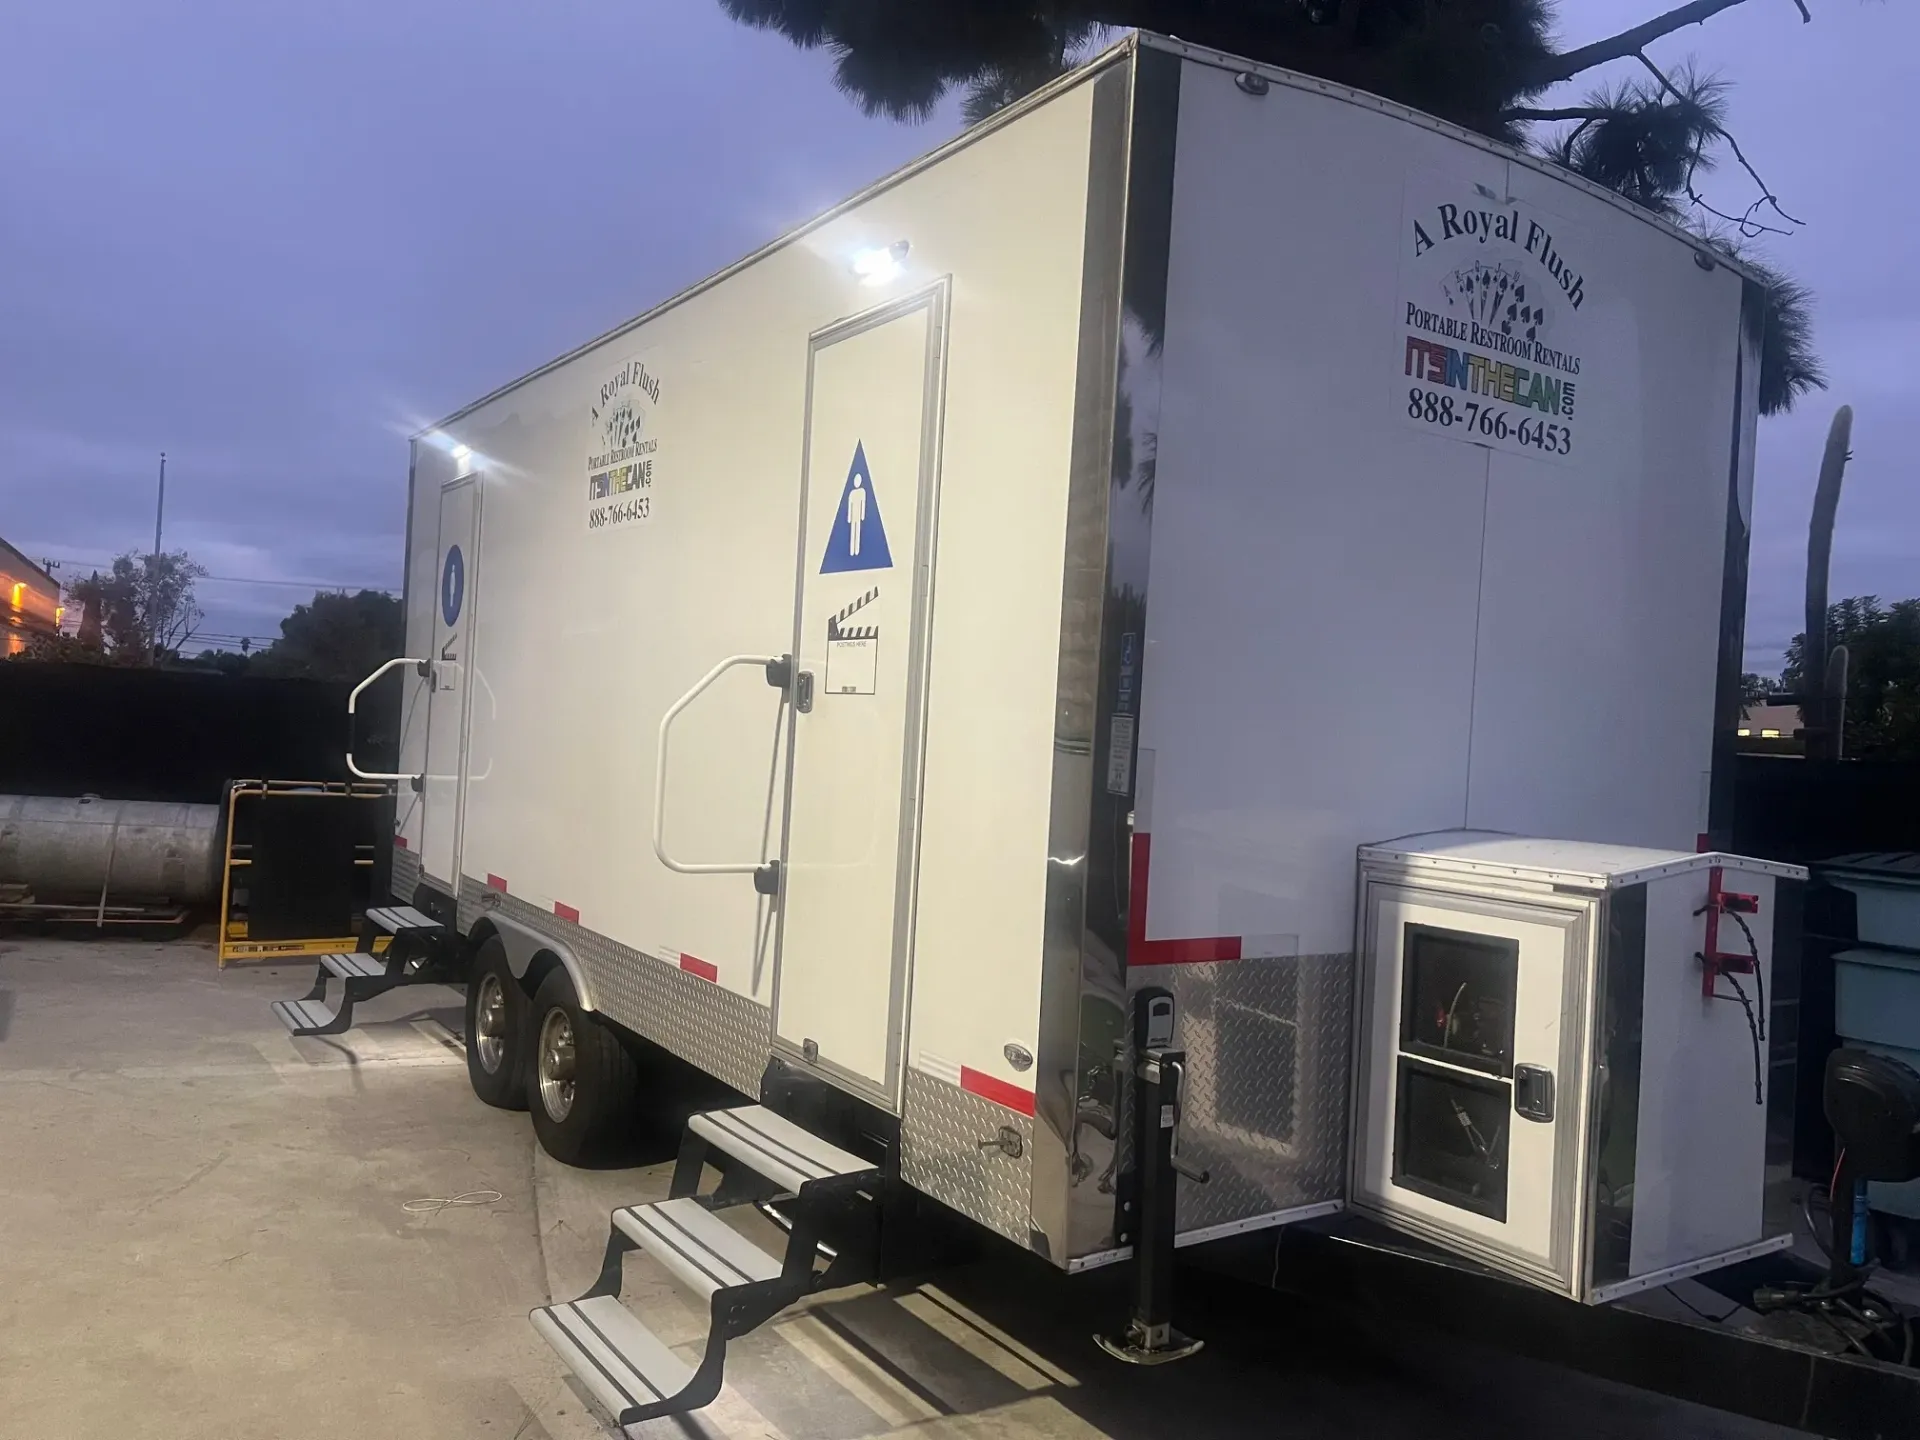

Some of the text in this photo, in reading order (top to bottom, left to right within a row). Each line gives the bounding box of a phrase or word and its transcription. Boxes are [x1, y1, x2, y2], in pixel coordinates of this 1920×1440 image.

[1413, 203, 1584, 312] A Royal Flush
[1406, 301, 1580, 375] PORTABLE RESTROOM RENTALS
[591, 361, 660, 428] A Royal Flush
[1408, 387, 1571, 455] 888-766-6453
[635, 438, 658, 457] RENTALS
[589, 496, 650, 529] 888-766-6453
